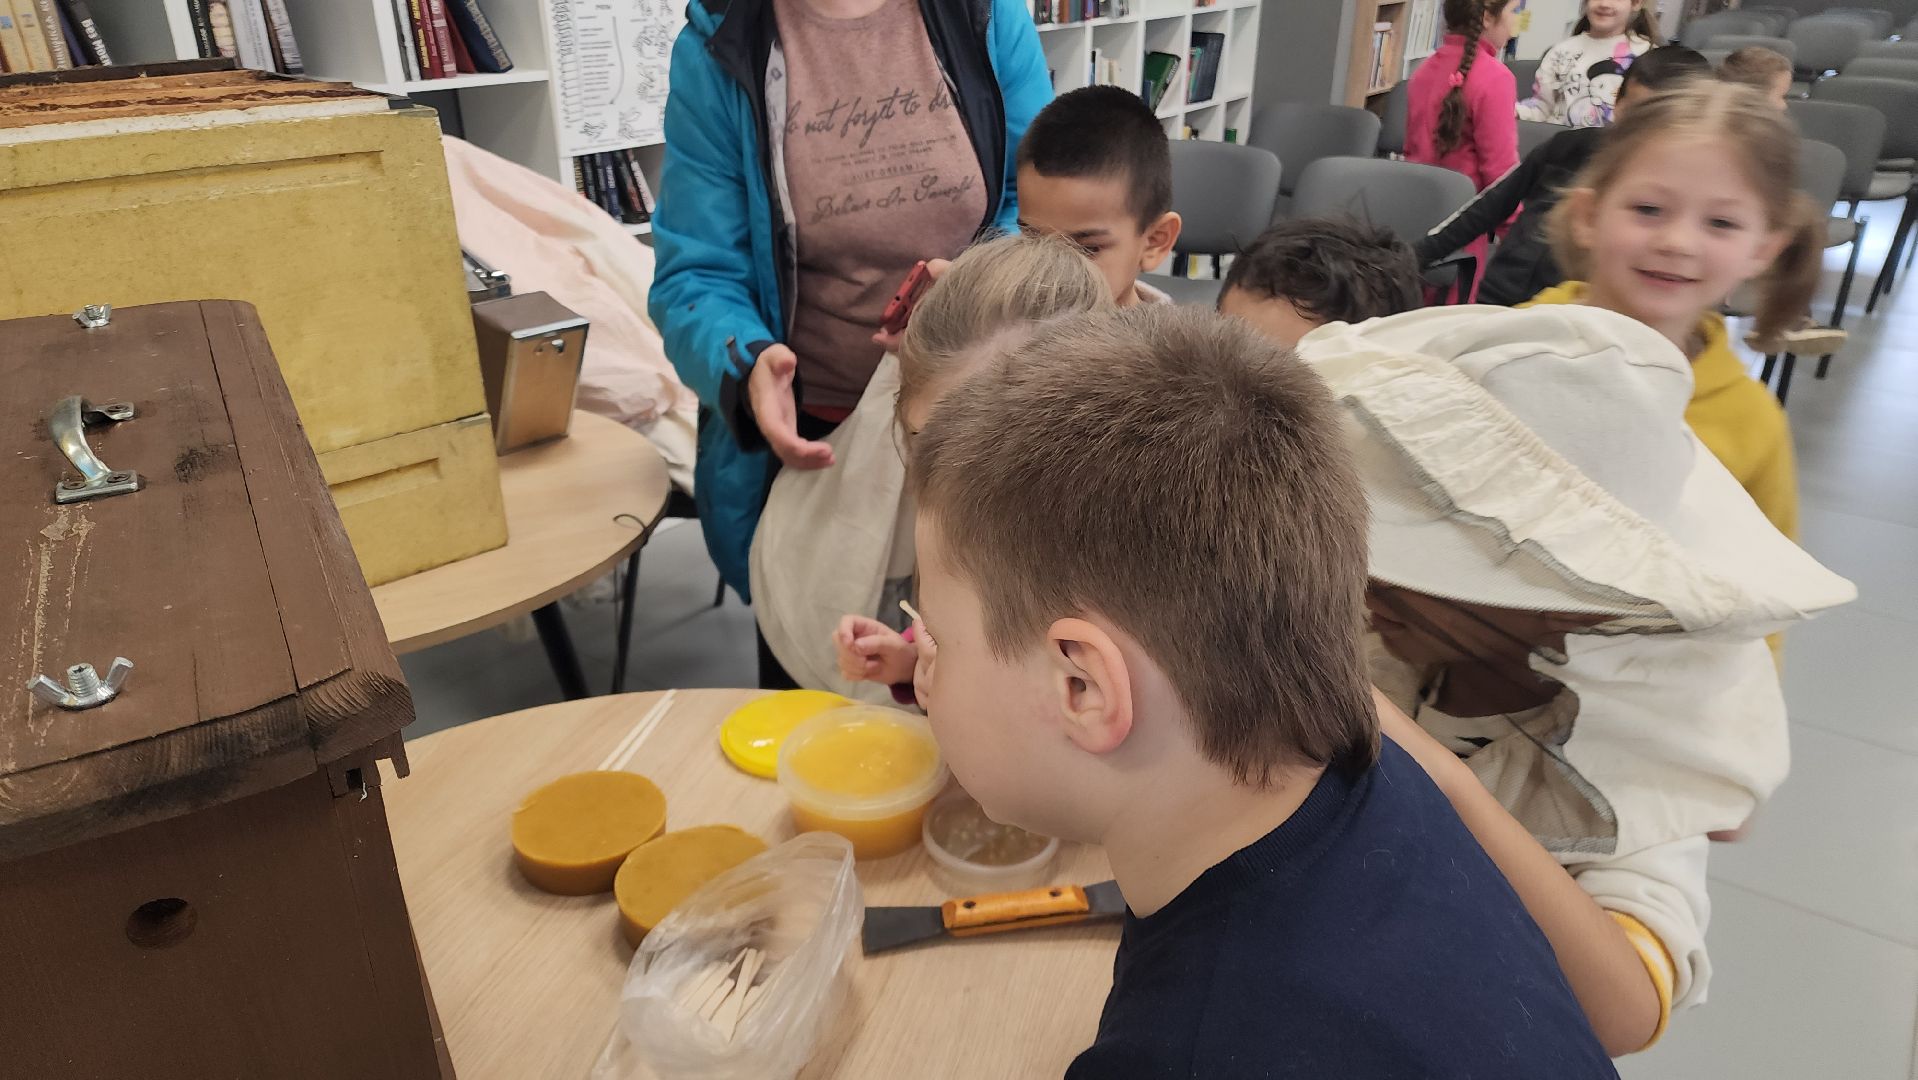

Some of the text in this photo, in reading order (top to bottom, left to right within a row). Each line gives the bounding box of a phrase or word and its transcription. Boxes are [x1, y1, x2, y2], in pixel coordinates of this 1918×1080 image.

[805, 99, 848, 136] not
[840, 87, 905, 148] forget
[900, 89, 920, 116] to
